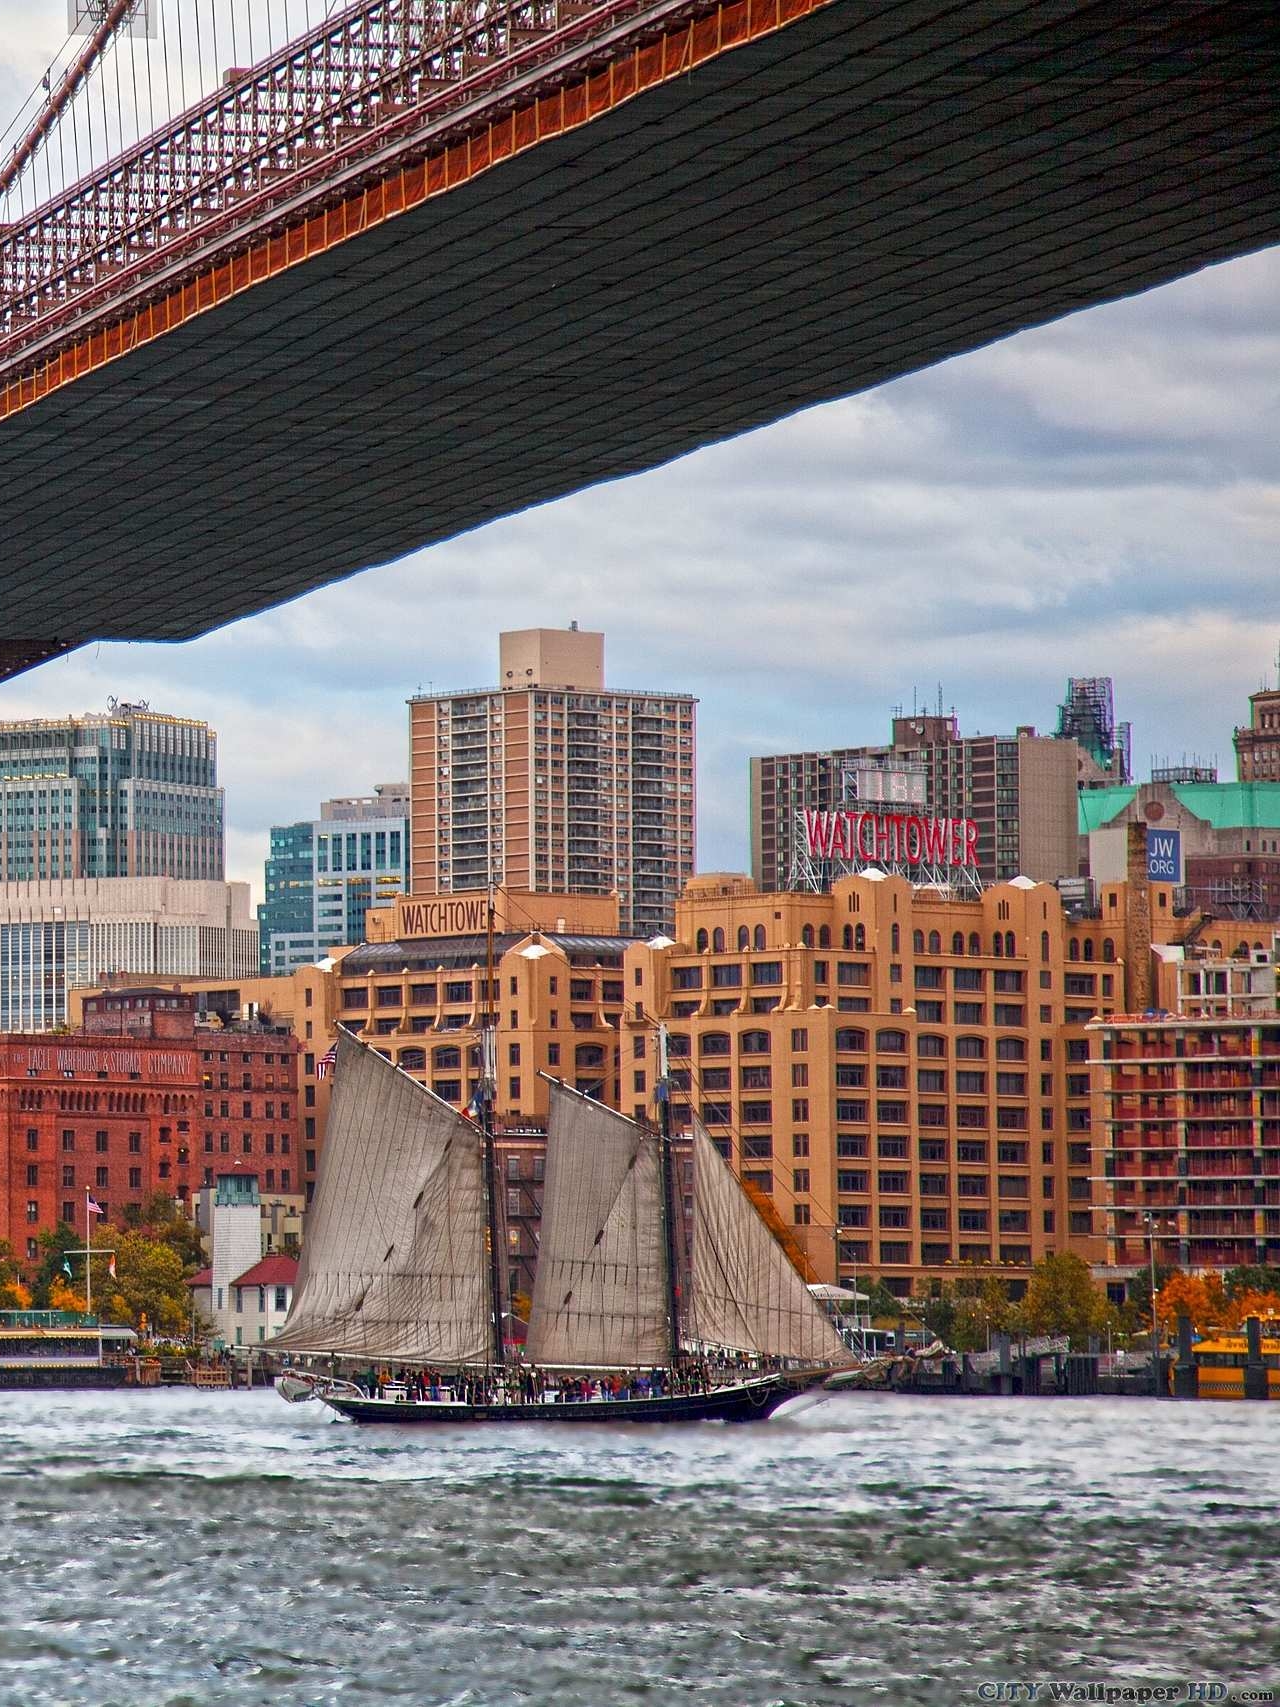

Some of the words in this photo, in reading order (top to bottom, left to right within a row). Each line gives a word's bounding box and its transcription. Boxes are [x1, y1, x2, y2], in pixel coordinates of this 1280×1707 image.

[803, 809, 980, 866] WATCHTOWER
[1150, 837, 1174, 858] JW
[1148, 859, 1174, 874] .ORG
[401, 900, 497, 935] WATCHTOWE
[56, 1049, 101, 1073] WAREHOUSE
[103, 1051, 110, 1072] &
[110, 1051, 143, 1074] STORAGE
[147, 1053, 192, 1076] COMPANY
